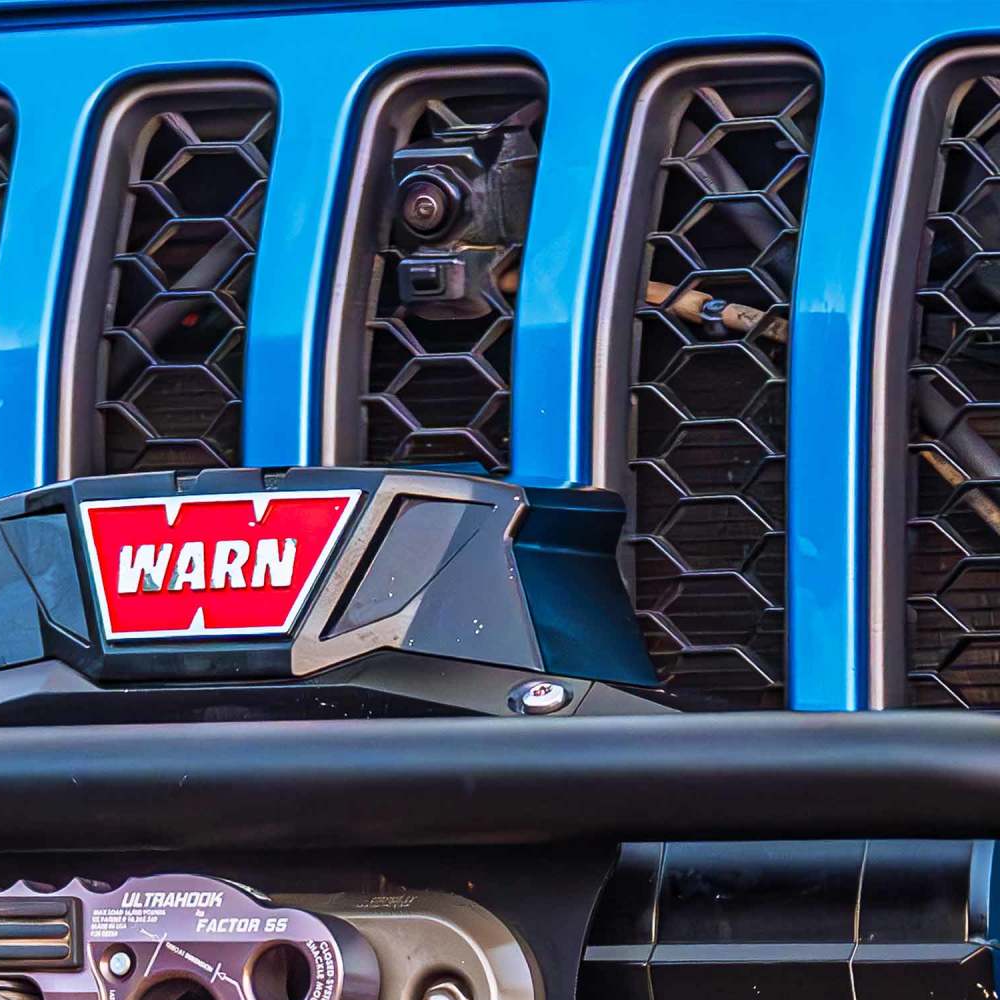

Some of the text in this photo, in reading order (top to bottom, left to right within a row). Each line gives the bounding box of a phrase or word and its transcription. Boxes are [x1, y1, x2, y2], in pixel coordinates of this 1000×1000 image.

[117, 538, 297, 596] WARN
[121, 891, 224, 909] ULTRAHOOK
[196, 918, 259, 933] FACTOR
